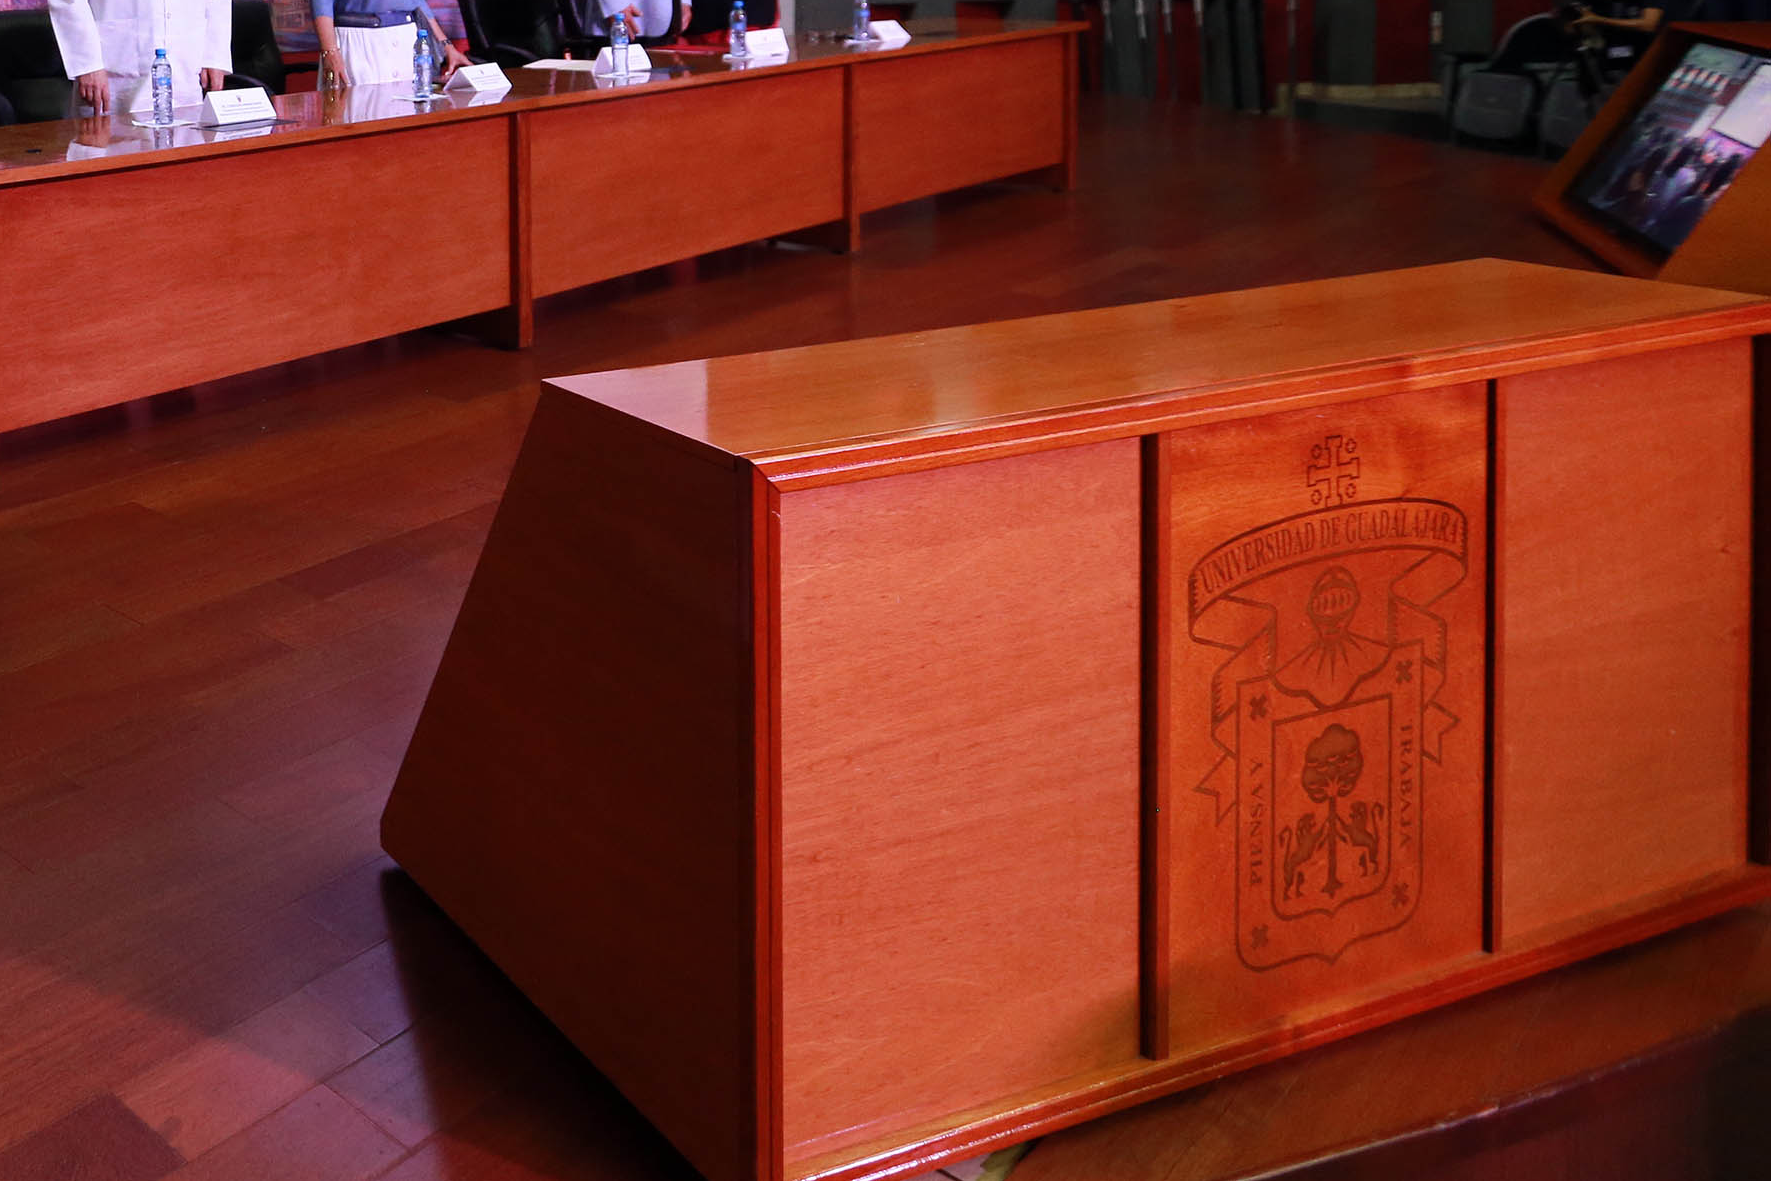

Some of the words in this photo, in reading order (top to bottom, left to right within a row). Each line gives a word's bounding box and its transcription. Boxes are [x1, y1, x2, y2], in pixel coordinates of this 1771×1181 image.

[1198, 521, 1316, 594] UNIVERSIDAD
[1320, 516, 1341, 549] DE
[1345, 507, 1459, 545] GUADALAJARA
[1250, 782, 1268, 887] PIENSA
[1399, 717, 1414, 850] TRABAJA
